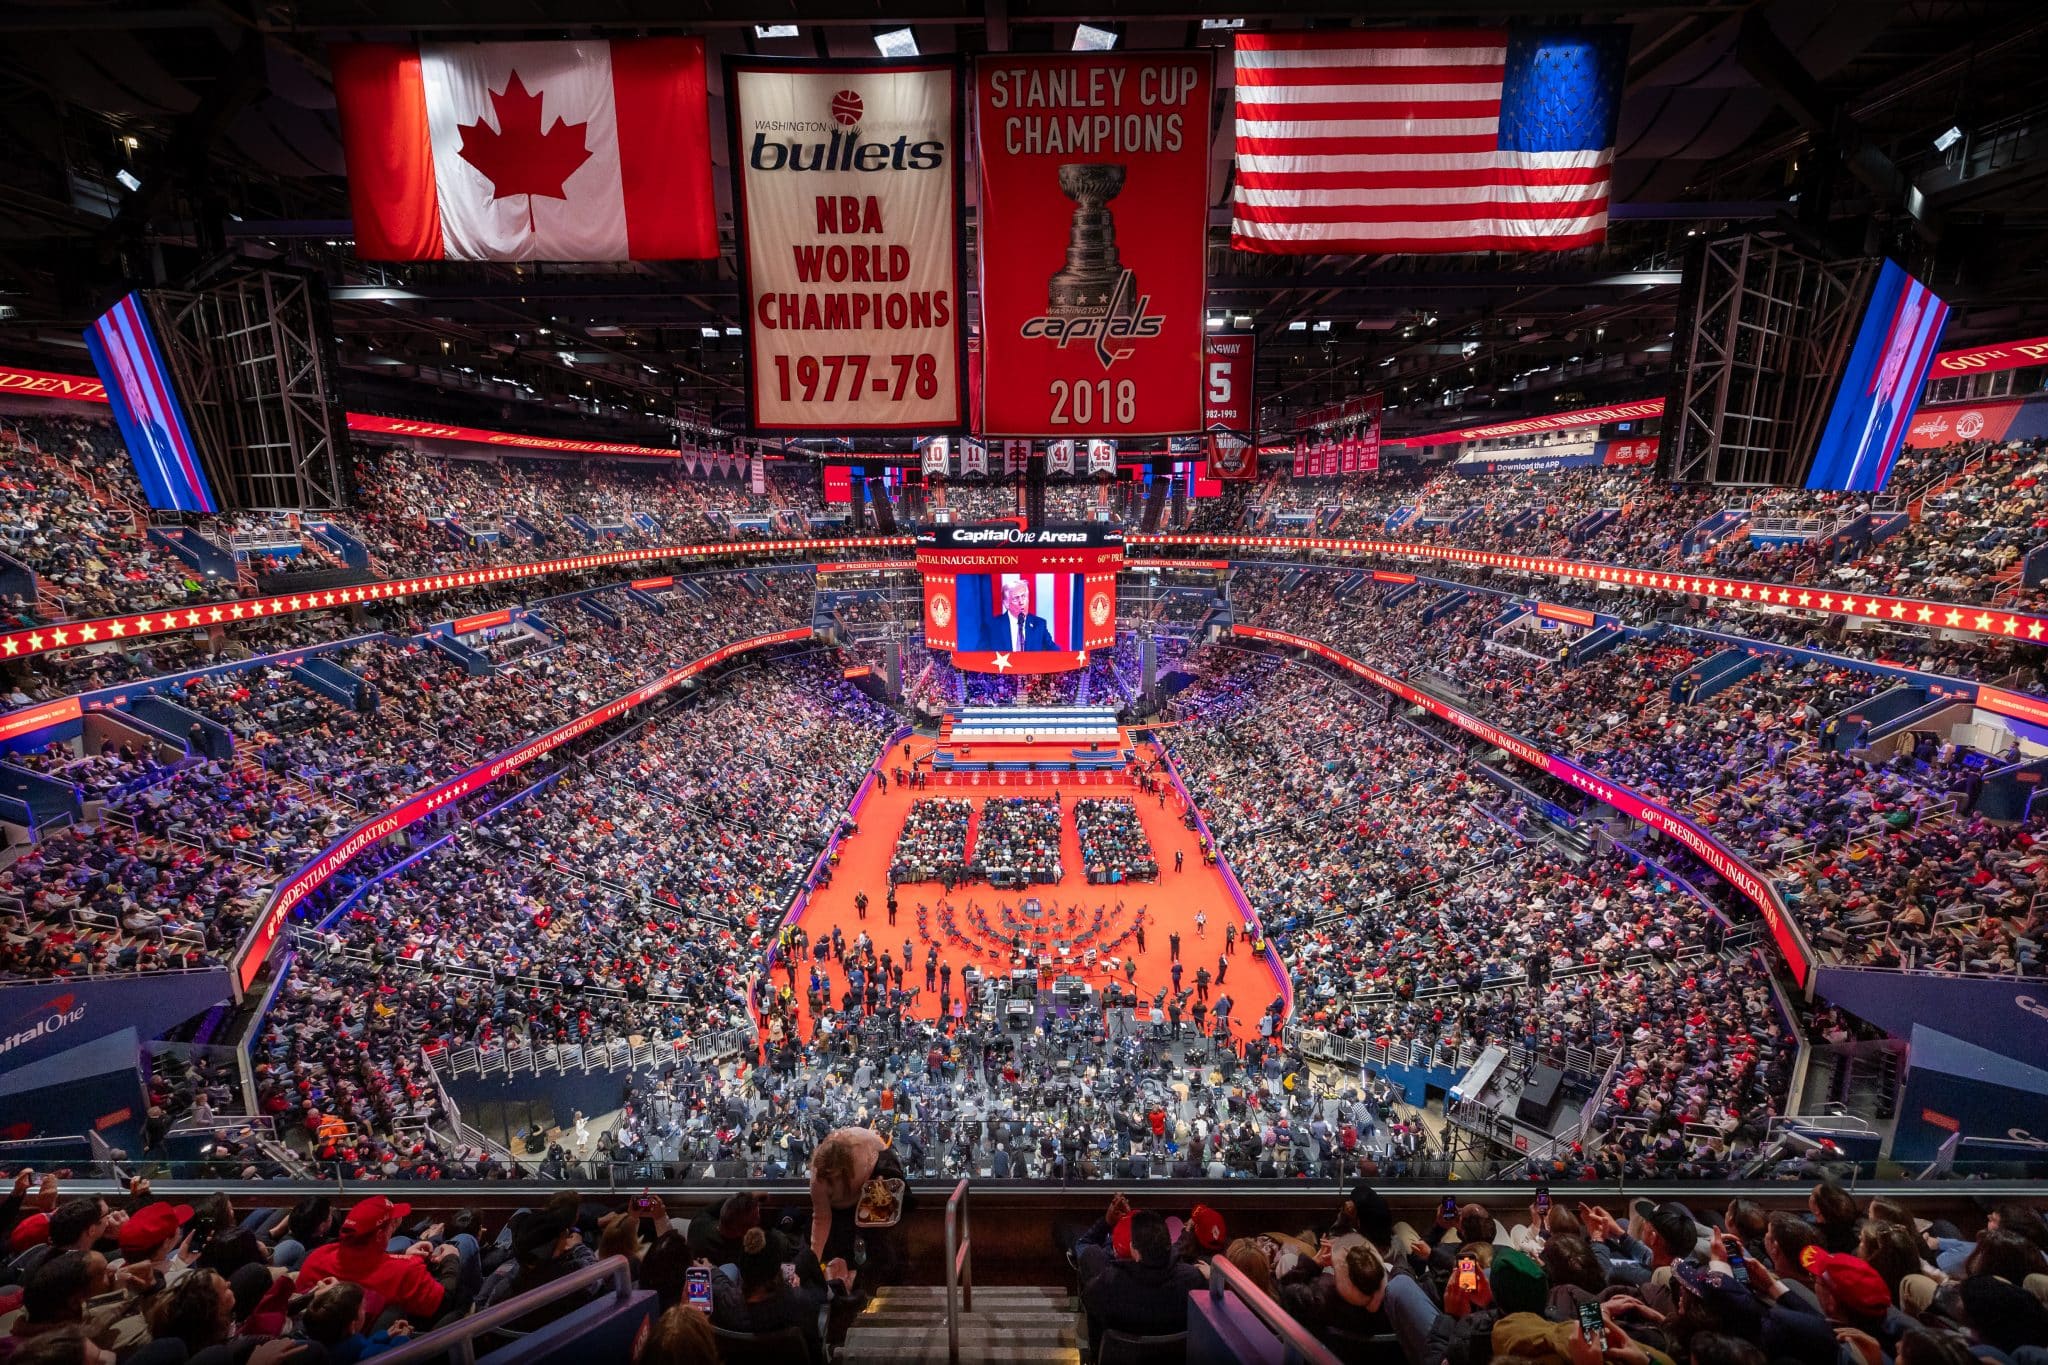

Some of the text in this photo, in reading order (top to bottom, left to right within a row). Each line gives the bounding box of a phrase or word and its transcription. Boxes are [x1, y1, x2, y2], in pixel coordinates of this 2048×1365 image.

[991, 66, 1198, 108] STANLEY CUP
[755, 120, 827, 132] WASHINGTON
[1005, 113, 1184, 155] CHAMPIONS
[750, 128, 945, 172] bullets
[815, 195, 884, 234] NBA
[793, 244, 911, 283] WORLD
[757, 290, 950, 330] CHAMPIONS
[1046, 306, 1107, 315] WASHINGTON
[774, 353, 938, 402] 1977-78
[1941, 350, 2010, 371] 60TH
[1050, 379, 1136, 424] 2018
[1209, 363, 1232, 403] 5
[1497, 463, 1533, 471] Download
[1545, 460, 1560, 468] APP
[1038, 531, 1088, 542] Arena
[940, 555, 1019, 565] INAUGURATION
[505, 739, 552, 769] PRESIDENTIAL
[552, 716, 595, 745] INAUGURATION
[1458, 715, 1497, 742] PRESIDENTIAL
[1498, 735, 1551, 768] INAUGURATION
[275, 867, 330, 924] PRESIDENTIAL
[328, 815, 399, 871] INAUGURATION
[1641, 807, 1779, 932] 60TH PRESIDENTIAL INAUGURATION
